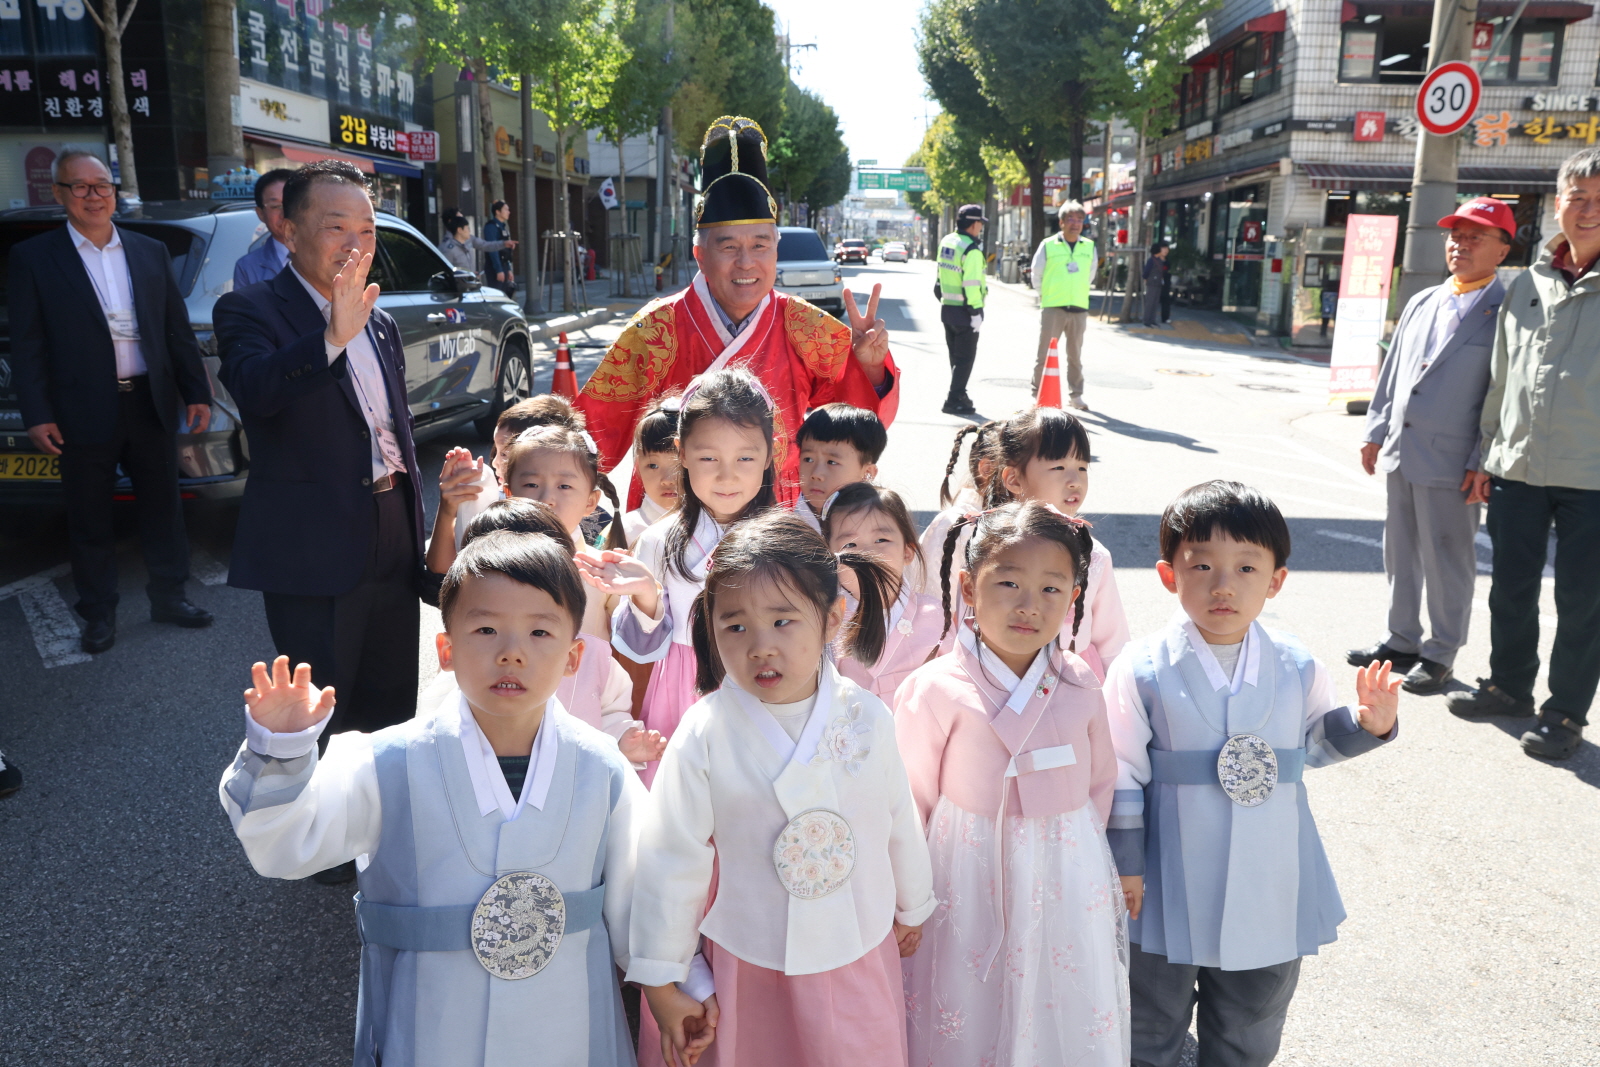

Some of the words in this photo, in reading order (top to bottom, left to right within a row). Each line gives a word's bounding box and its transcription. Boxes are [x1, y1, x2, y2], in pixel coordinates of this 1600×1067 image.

[44, 96, 150, 118] 친환경색
[1430, 83, 1465, 114] 30
[1532, 93, 1590, 112] SINCE
[340, 114, 367, 145] 강남
[370, 124, 397, 151] 부동산
[411, 133, 434, 145] 강남
[411, 145, 434, 154] 부동산
[228, 187, 248, 196] TAXI
[439, 329, 476, 364] MyCab
[13, 457, 60, 477] 2028
